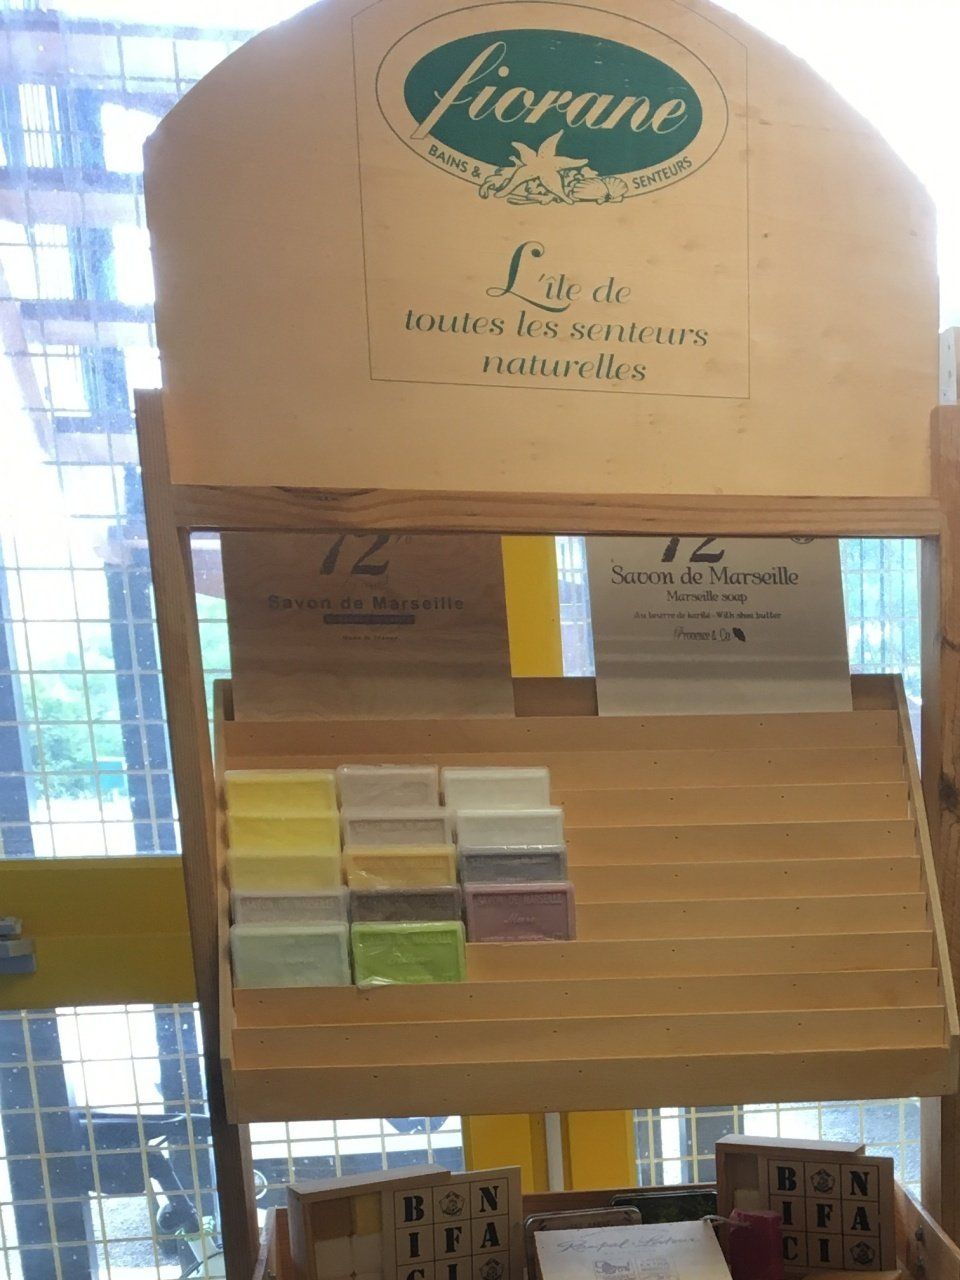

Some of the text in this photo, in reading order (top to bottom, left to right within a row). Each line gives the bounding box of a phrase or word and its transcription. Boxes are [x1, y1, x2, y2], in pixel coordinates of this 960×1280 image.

[410, 41, 689, 139] fiorane
[427, 143, 694, 190] BAINS & SENTEURS
[592, 277, 632, 304] de
[405, 309, 709, 347] toutes les senteurs
[482, 353, 648, 382] naturelles
[611, 565, 800, 586] Savon de Marseille
[267, 594, 465, 610] Savon de Marseille
[666, 589, 748, 605] Marseille soap
